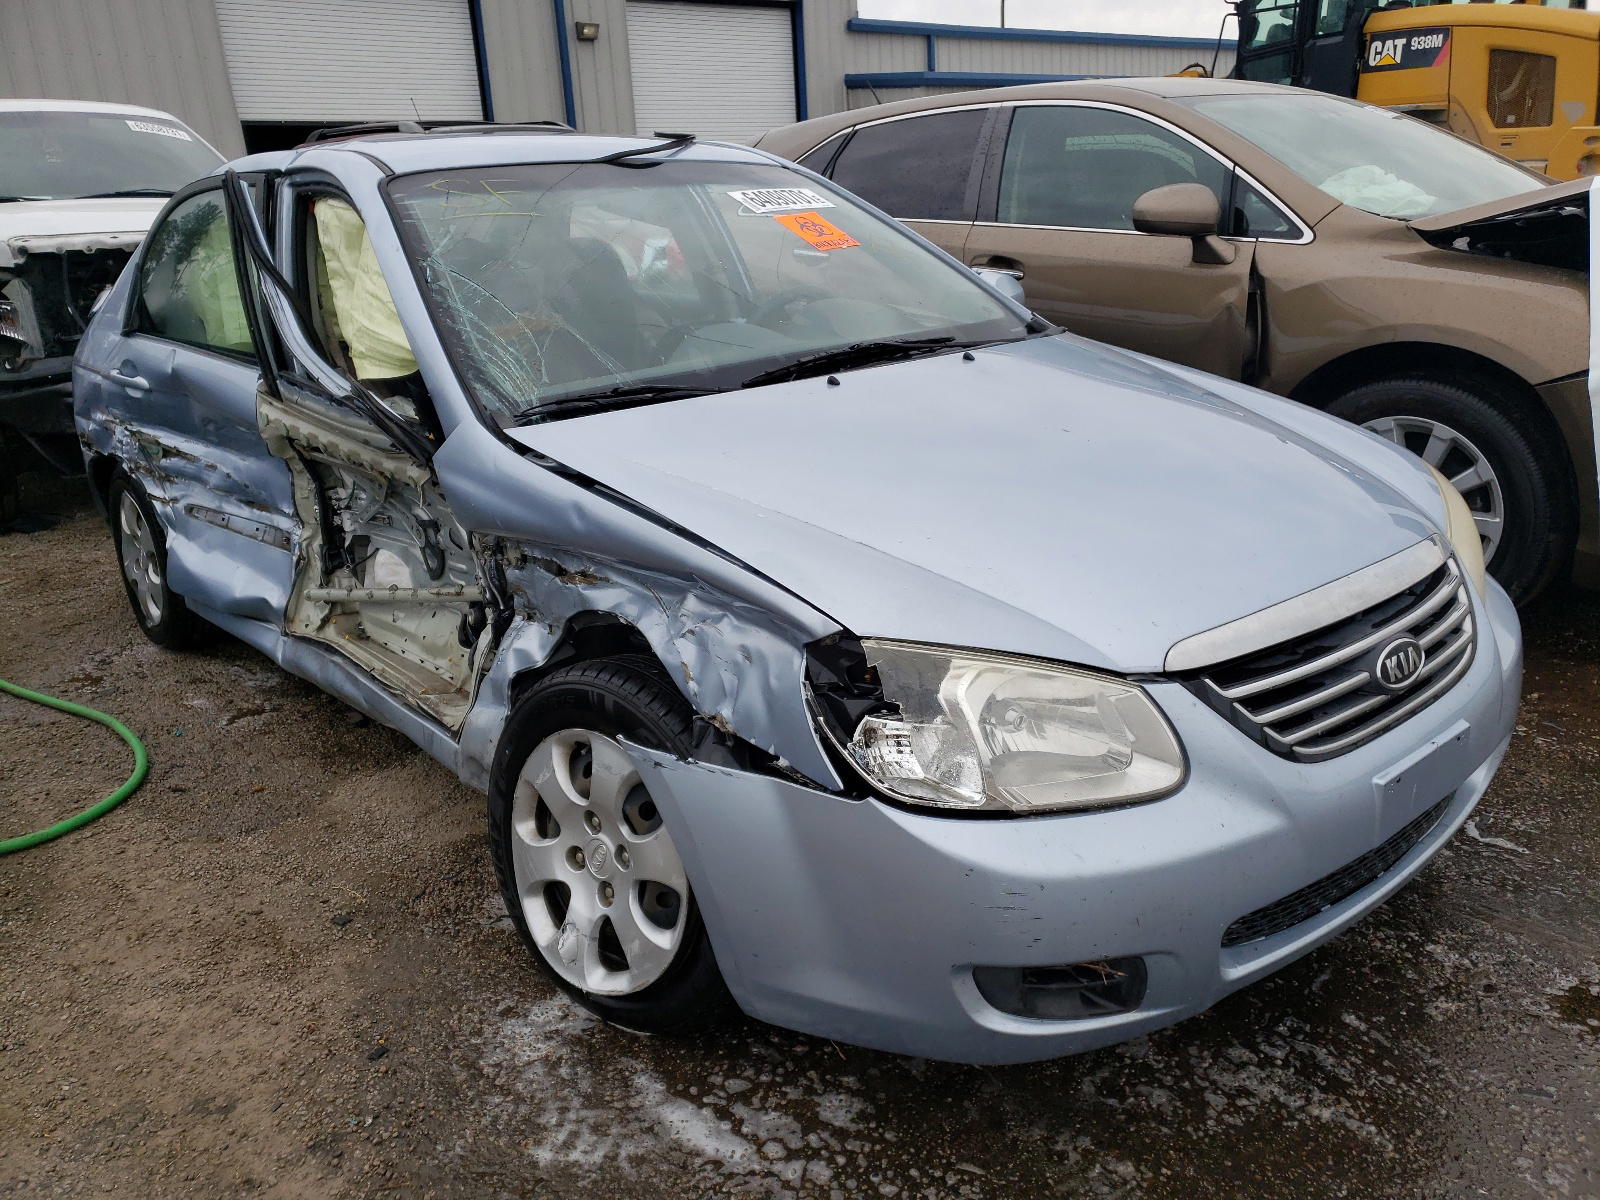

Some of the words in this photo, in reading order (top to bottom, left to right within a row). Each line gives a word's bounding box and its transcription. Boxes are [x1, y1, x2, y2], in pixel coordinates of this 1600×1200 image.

[1368, 38, 1407, 67] CAT
[1410, 33, 1444, 50] 938M
[741, 189, 813, 208] 64090701
[1384, 646, 1421, 682] KIA
